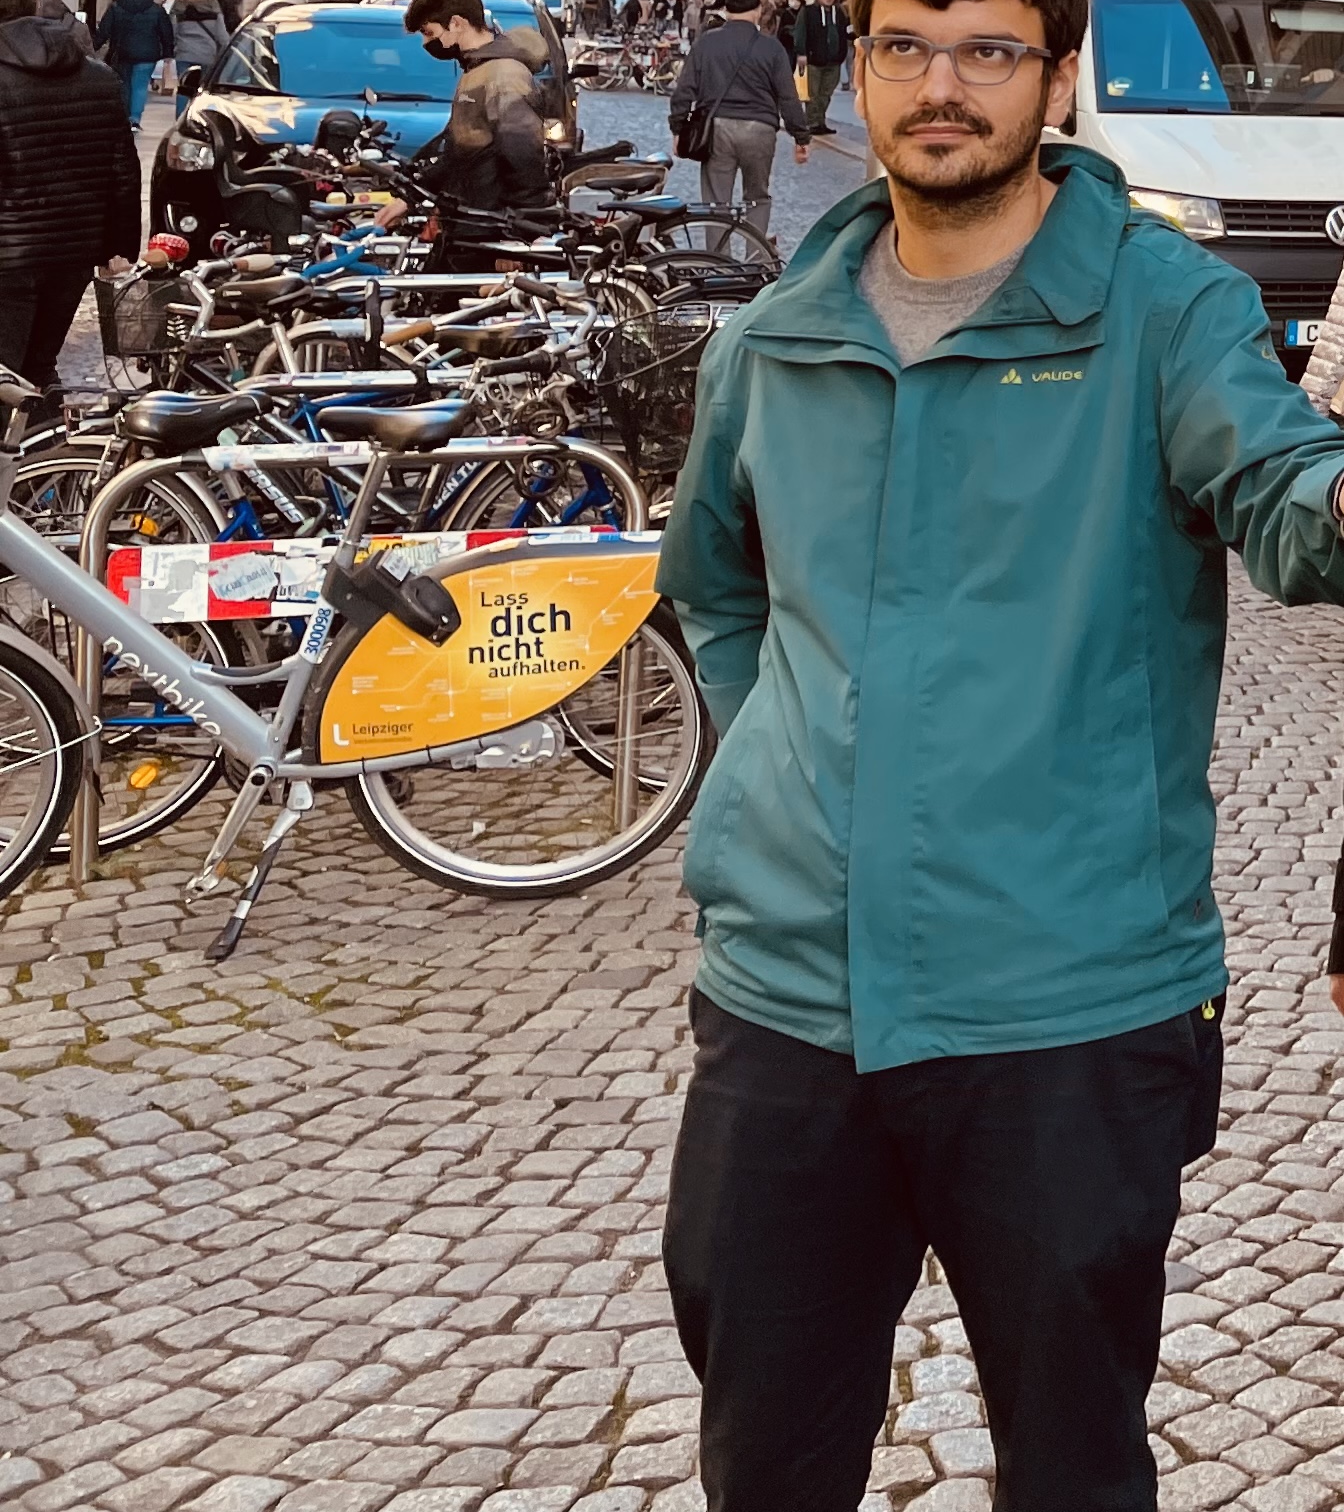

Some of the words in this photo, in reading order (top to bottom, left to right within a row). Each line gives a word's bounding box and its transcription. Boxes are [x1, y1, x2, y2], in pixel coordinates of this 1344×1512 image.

[1031, 369, 1084, 383] VAUDE
[480, 590, 528, 608] Lass
[304, 607, 332, 655] 300098
[490, 603, 571, 637] dich
[468, 637, 544, 665] nicht
[487, 656, 586, 679] aufhalten.
[102, 635, 222, 736] nextbike
[352, 722, 414, 737] Leipziger
